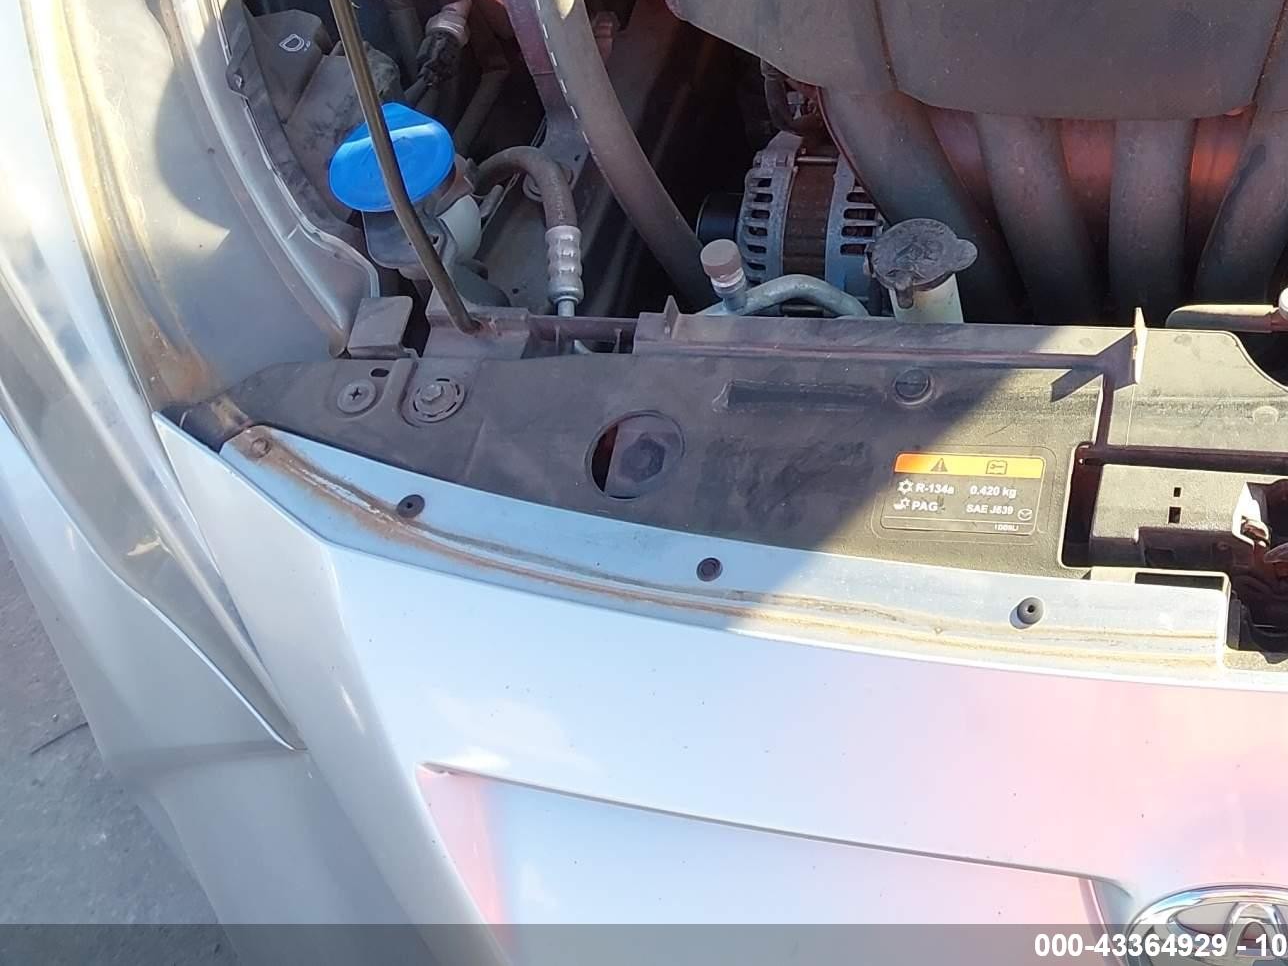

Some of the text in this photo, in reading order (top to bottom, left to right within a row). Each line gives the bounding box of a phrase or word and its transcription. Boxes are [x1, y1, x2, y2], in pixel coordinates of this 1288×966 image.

[915, 484, 1017, 498] R-134a 0.420 kg
[911, 501, 938, 512] PAG
[966, 504, 989, 514] SAE
